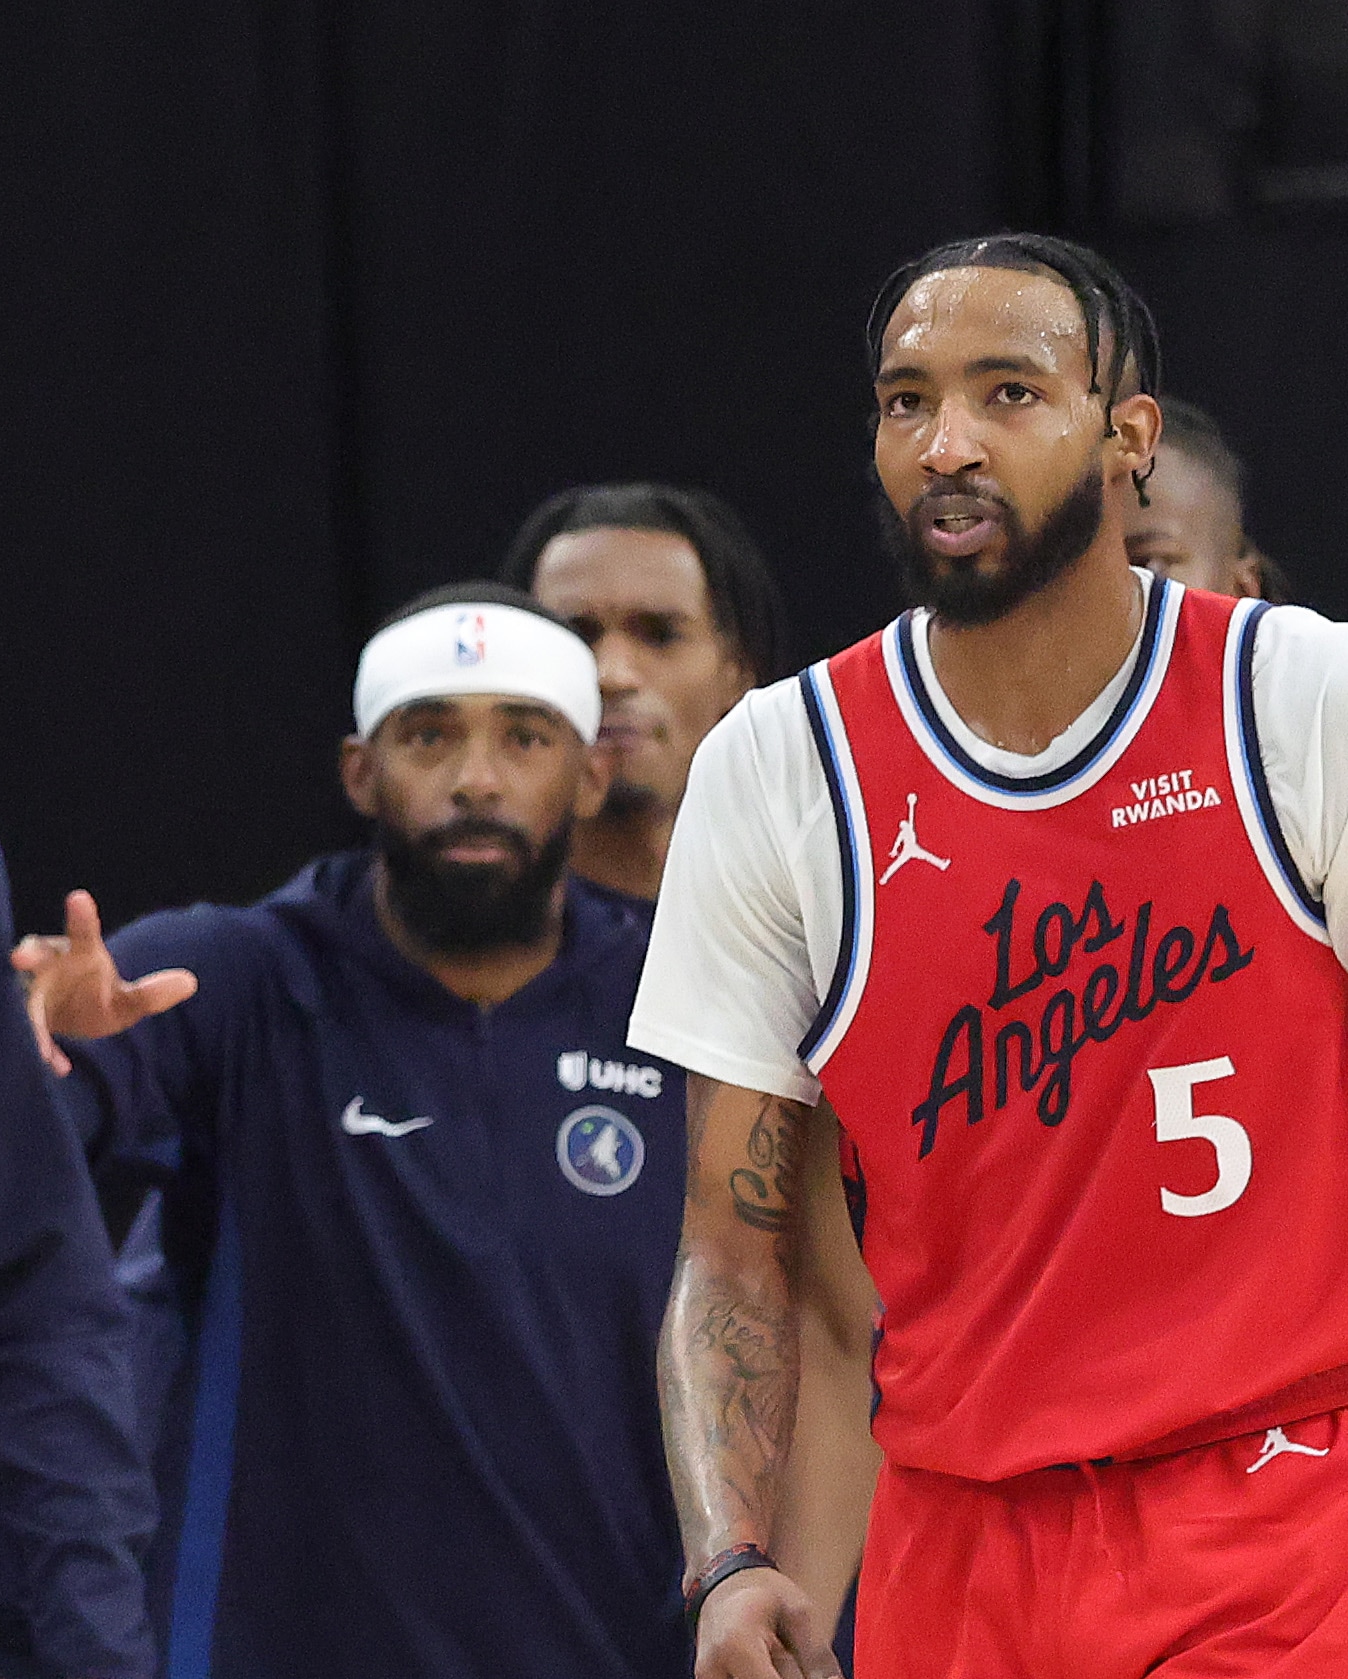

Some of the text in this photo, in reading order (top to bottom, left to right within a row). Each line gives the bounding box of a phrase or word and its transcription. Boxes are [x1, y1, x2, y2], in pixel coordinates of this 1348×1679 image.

[1111, 786, 1222, 828] RWANDA
[1130, 769, 1193, 801] VISIT
[983, 877, 1126, 1011] Los
[911, 899, 1255, 1161] Angeles
[1146, 1054, 1253, 1218] 5
